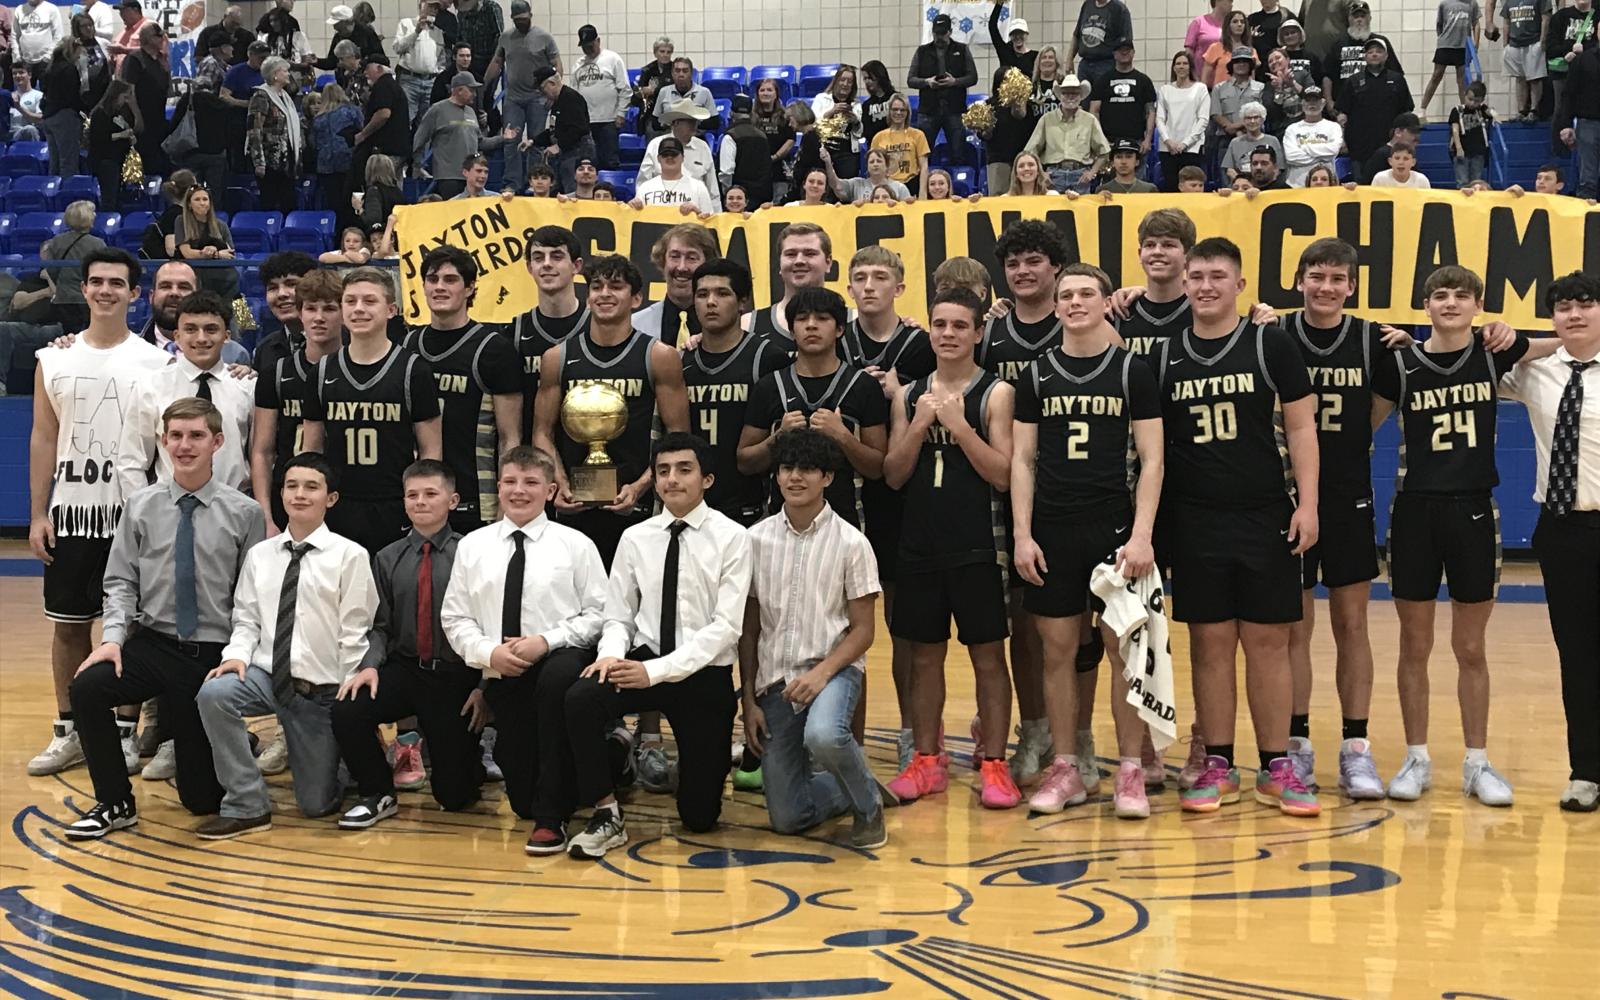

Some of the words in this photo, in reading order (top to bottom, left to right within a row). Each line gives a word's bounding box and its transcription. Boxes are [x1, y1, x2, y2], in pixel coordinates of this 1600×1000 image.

[1257, 200, 1600, 321] CHAM
[686, 383, 749, 403] AYTON
[1171, 373, 1255, 402] JAYTON
[1306, 366, 1363, 387] YTON
[51, 375, 136, 425] FEA
[327, 402, 401, 422] JAYTON
[1041, 395, 1124, 417] JAYTON
[1314, 393, 1344, 432] 2
[1410, 381, 1492, 411] JAYTON
[699, 408, 719, 446] 4
[1067, 421, 1090, 460] 2
[1188, 401, 1239, 444] 30
[1431, 410, 1477, 452] 24
[71, 428, 119, 458] the
[344, 427, 378, 465] 10
[56, 458, 114, 485] FLOC
[932, 450, 945, 488] 1
